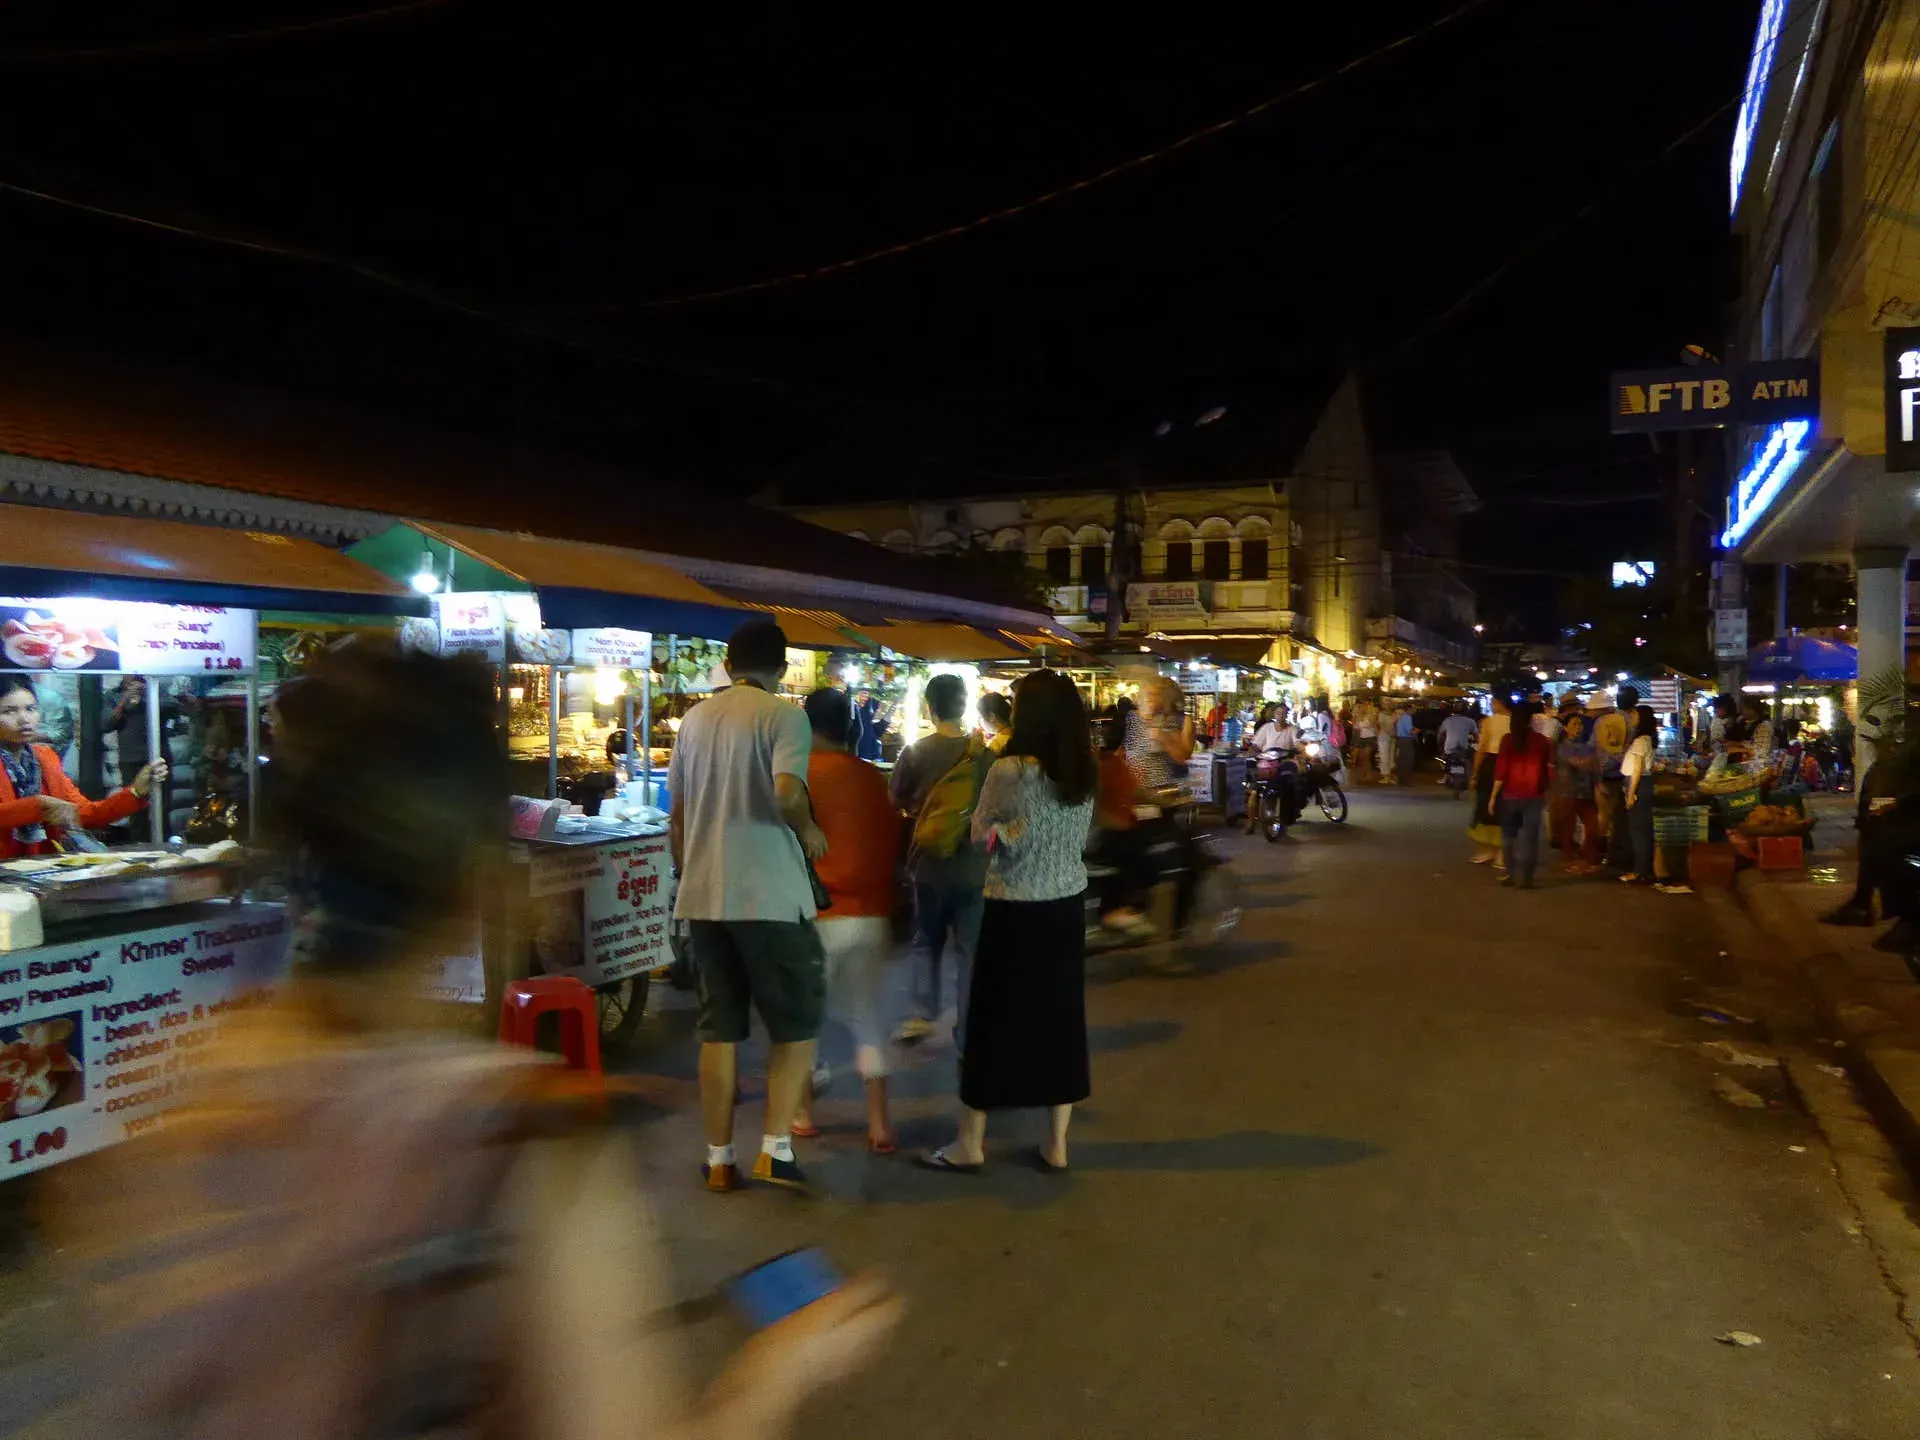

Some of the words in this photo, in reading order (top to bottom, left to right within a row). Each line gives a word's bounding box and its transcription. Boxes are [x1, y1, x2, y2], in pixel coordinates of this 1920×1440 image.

[1649, 379, 1731, 412] FTB
[1752, 378, 1809, 400] ATM
[120, 937, 189, 965] Khmer
[181, 951, 236, 976] Sweet
[8, 1126, 68, 1164] 1.00
